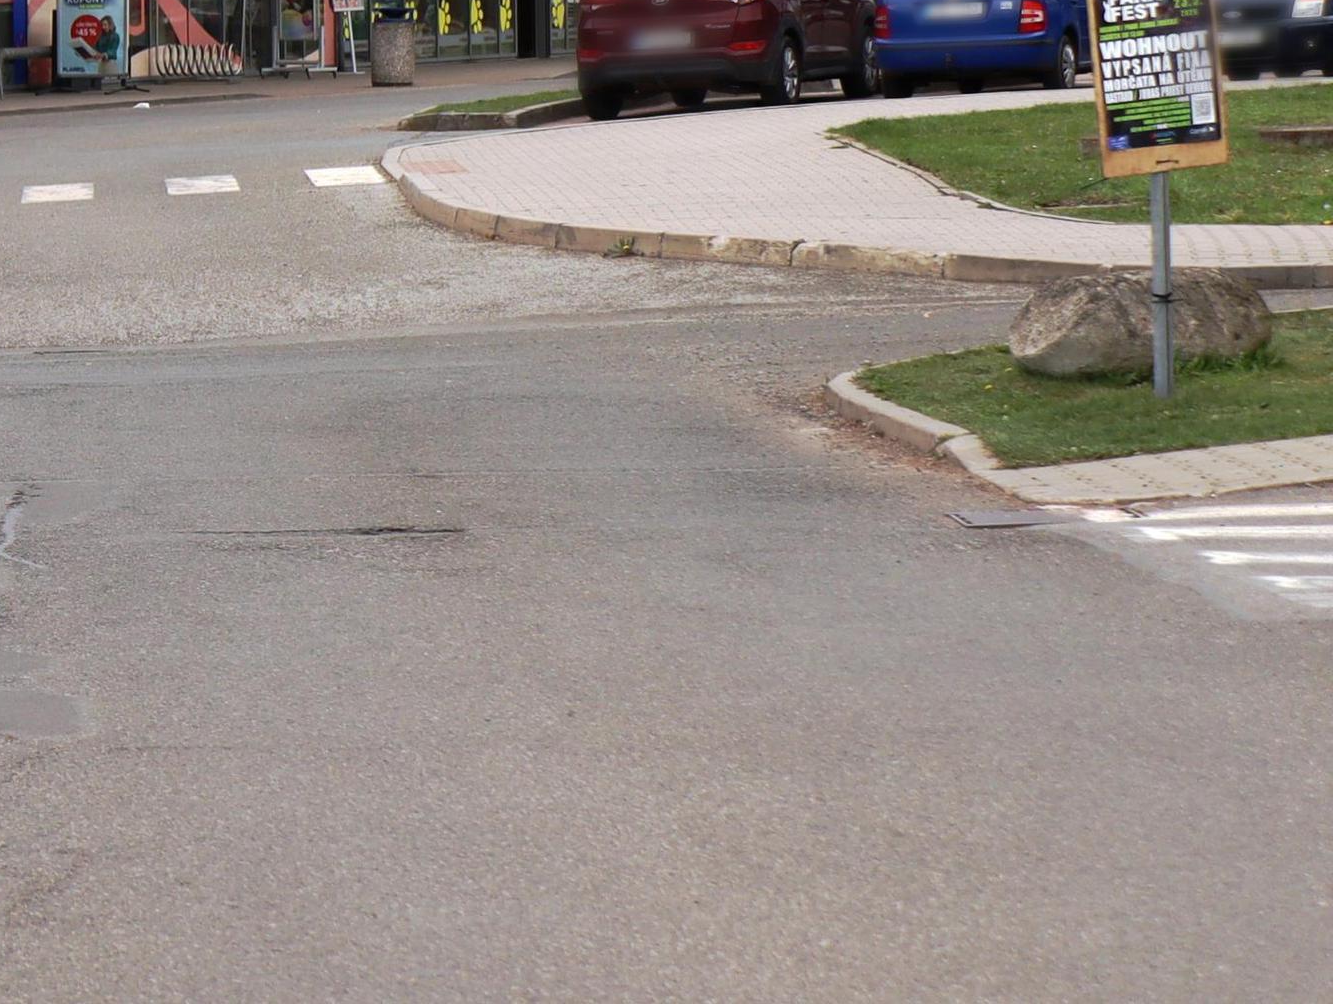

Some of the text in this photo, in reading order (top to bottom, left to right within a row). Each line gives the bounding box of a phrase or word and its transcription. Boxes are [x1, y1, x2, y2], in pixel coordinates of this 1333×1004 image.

[1107, 2, 1160, 22] FEST
[1099, 30, 1208, 60] WOHNOUT
[1101, 51, 1173, 78] VYPSANÁ
